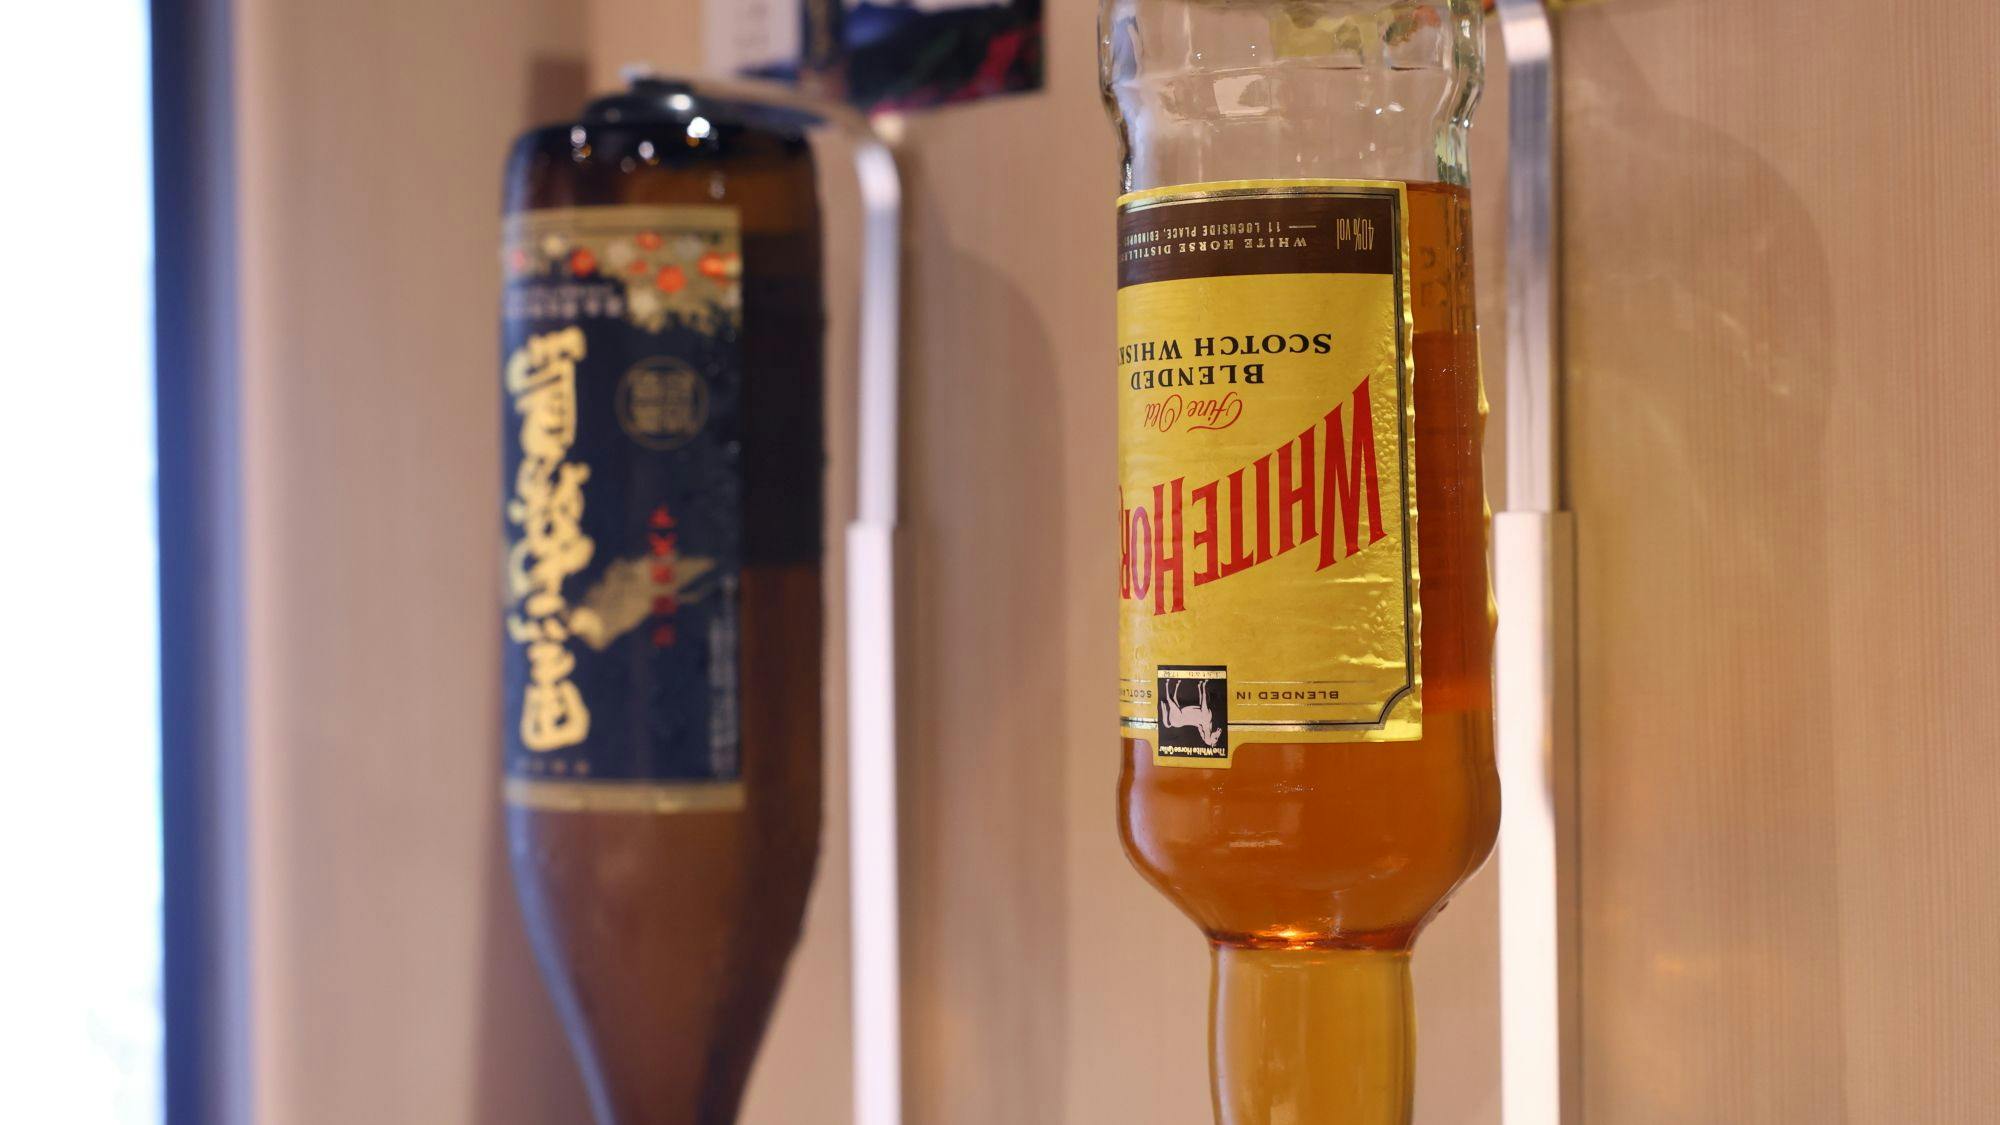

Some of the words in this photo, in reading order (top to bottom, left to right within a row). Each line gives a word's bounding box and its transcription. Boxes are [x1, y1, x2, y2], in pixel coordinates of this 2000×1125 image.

[1163, 225, 1197, 241] PLACE,
[1202, 222, 1260, 237] LOCHSIDE
[1267, 221, 1281, 233] 11
[1336, 218, 1352, 250] vol
[1352, 218, 1375, 251] 40%
[1178, 239, 1234, 254] HORSE
[1243, 236, 1307, 249] WHITE
[1119, 340, 1182, 366] WHISK
[1194, 333, 1332, 358] SCOTCH
[1130, 363, 1264, 391] BLENDED
[1144, 393, 1183, 433] Old
[1186, 391, 1243, 433] Fine
[1192, 374, 1388, 586] WHITE
[1119, 476, 1186, 617] HOR
[1236, 690, 1252, 701] IN
[1258, 690, 1339, 700] BLENDED
[1213, 747, 1226, 756] The
